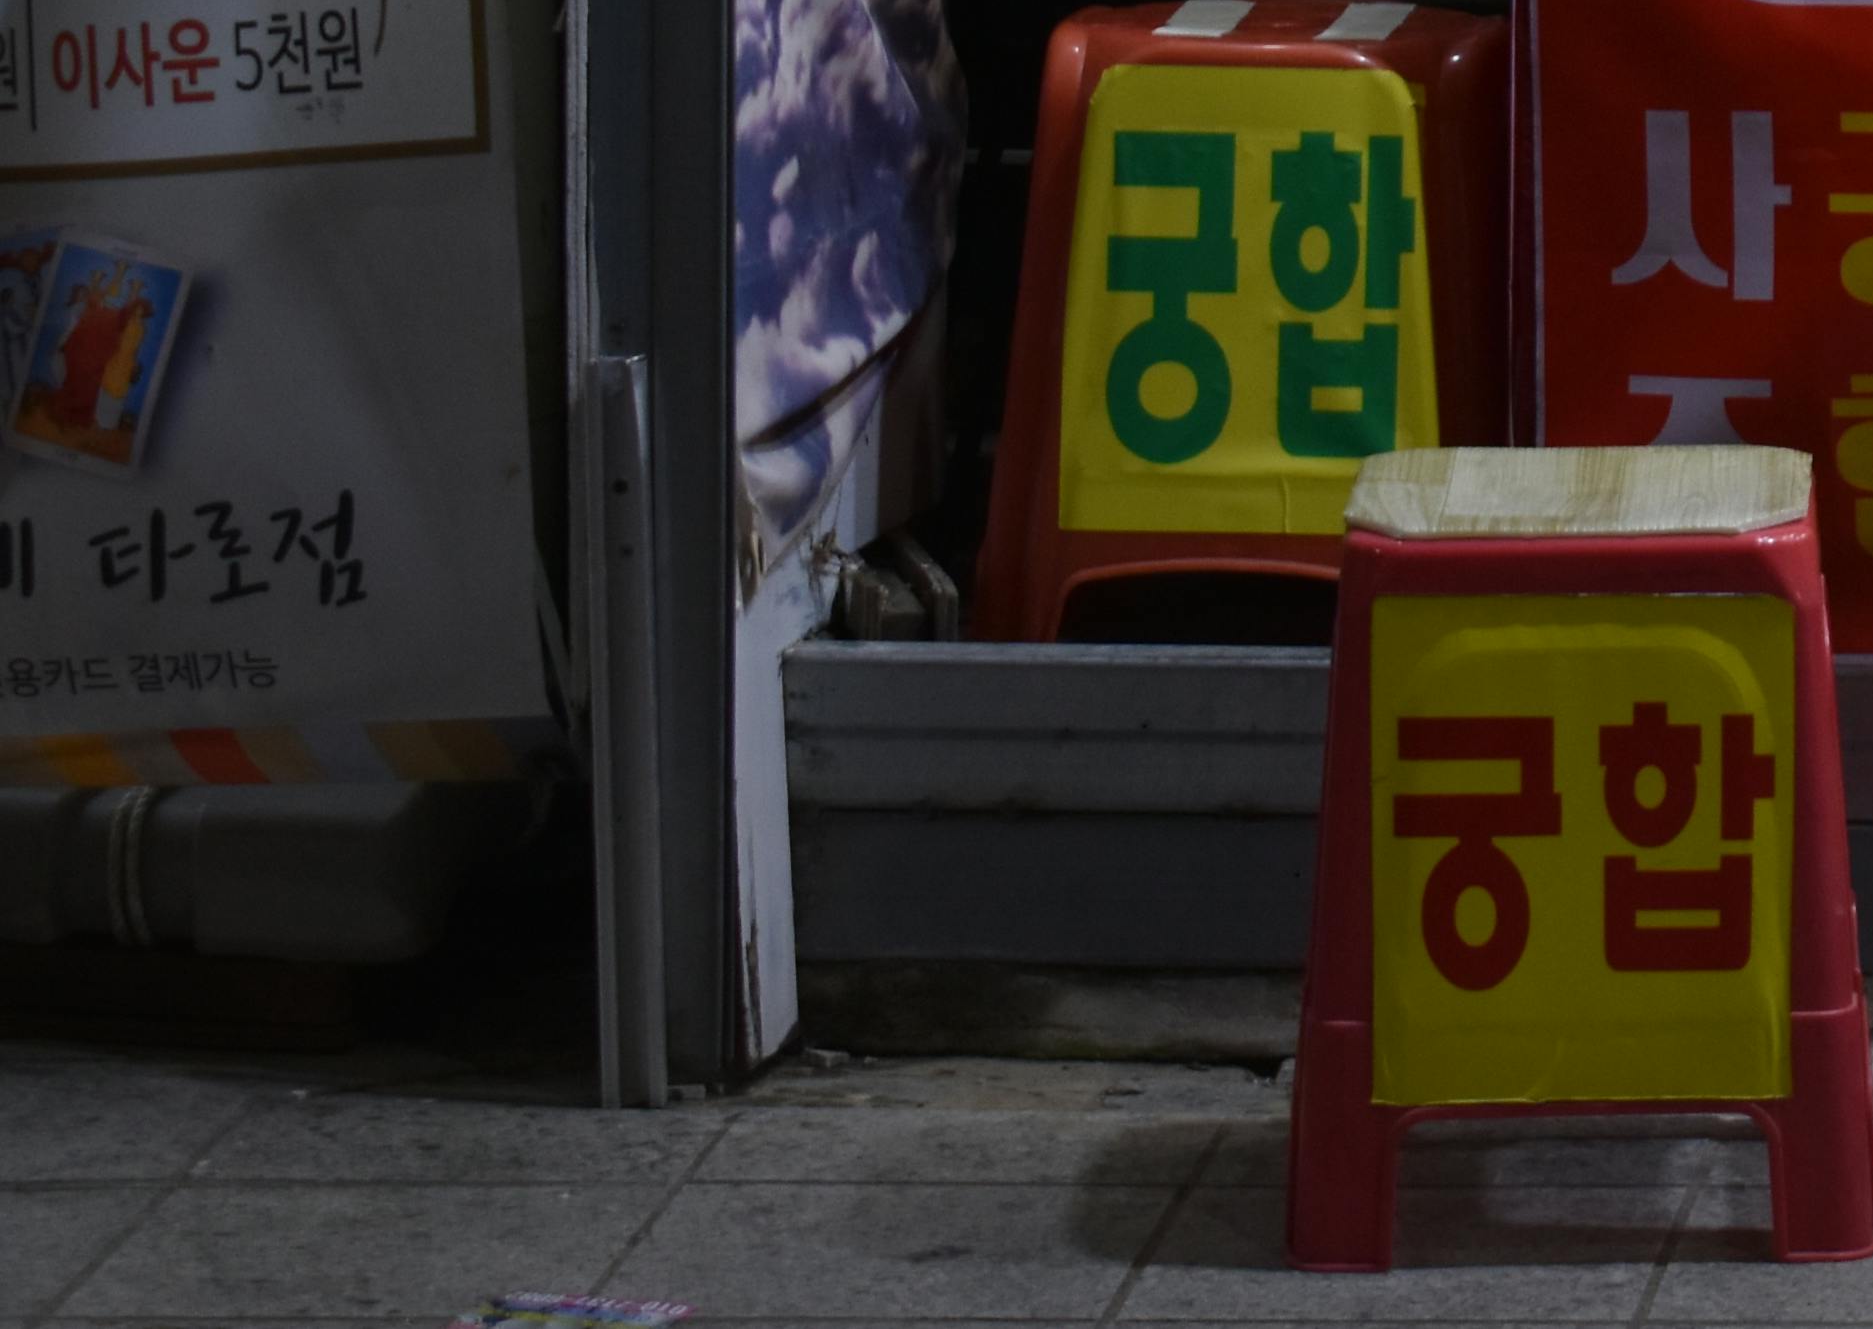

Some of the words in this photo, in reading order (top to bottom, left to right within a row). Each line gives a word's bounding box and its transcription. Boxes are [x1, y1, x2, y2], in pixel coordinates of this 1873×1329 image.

[52, 18, 219, 109] 이사운
[234, 7, 363, 95] 5천원
[1106, 130, 1414, 463] 궁합
[89, 488, 367, 607] 타로점
[1391, 700, 1776, 992] 궁합
